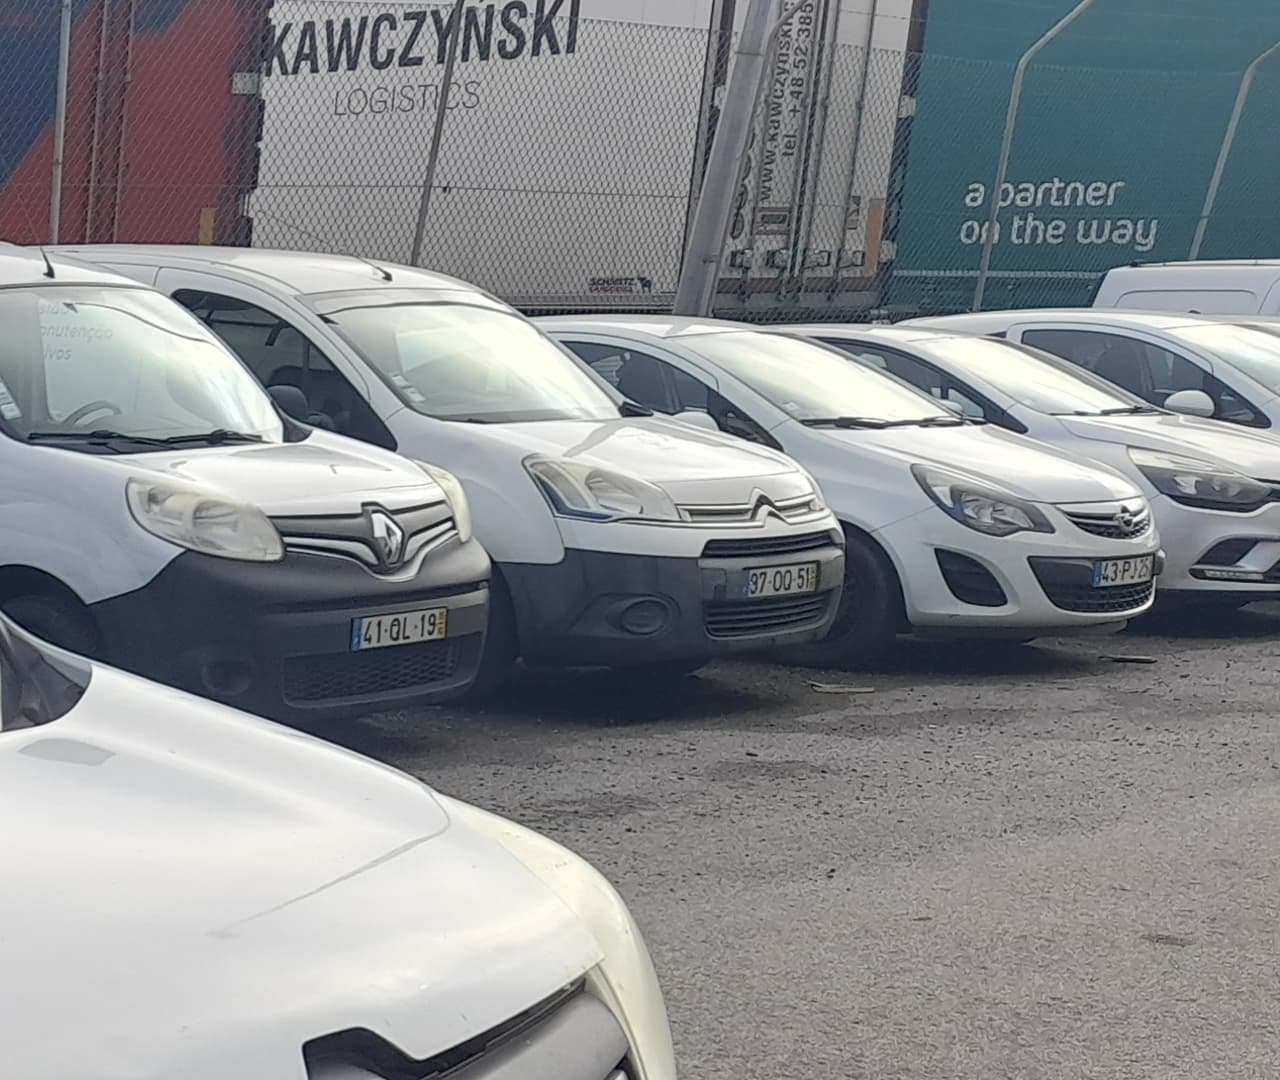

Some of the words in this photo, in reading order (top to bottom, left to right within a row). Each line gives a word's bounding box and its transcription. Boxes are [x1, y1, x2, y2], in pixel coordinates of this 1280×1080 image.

[334, 80, 482, 116] LOGISTICS
[964, 182, 985, 207] a
[997, 177, 1126, 208] partner
[959, 219, 1001, 245] on
[1010, 212, 1067, 245] the
[1075, 218, 1159, 252] way
